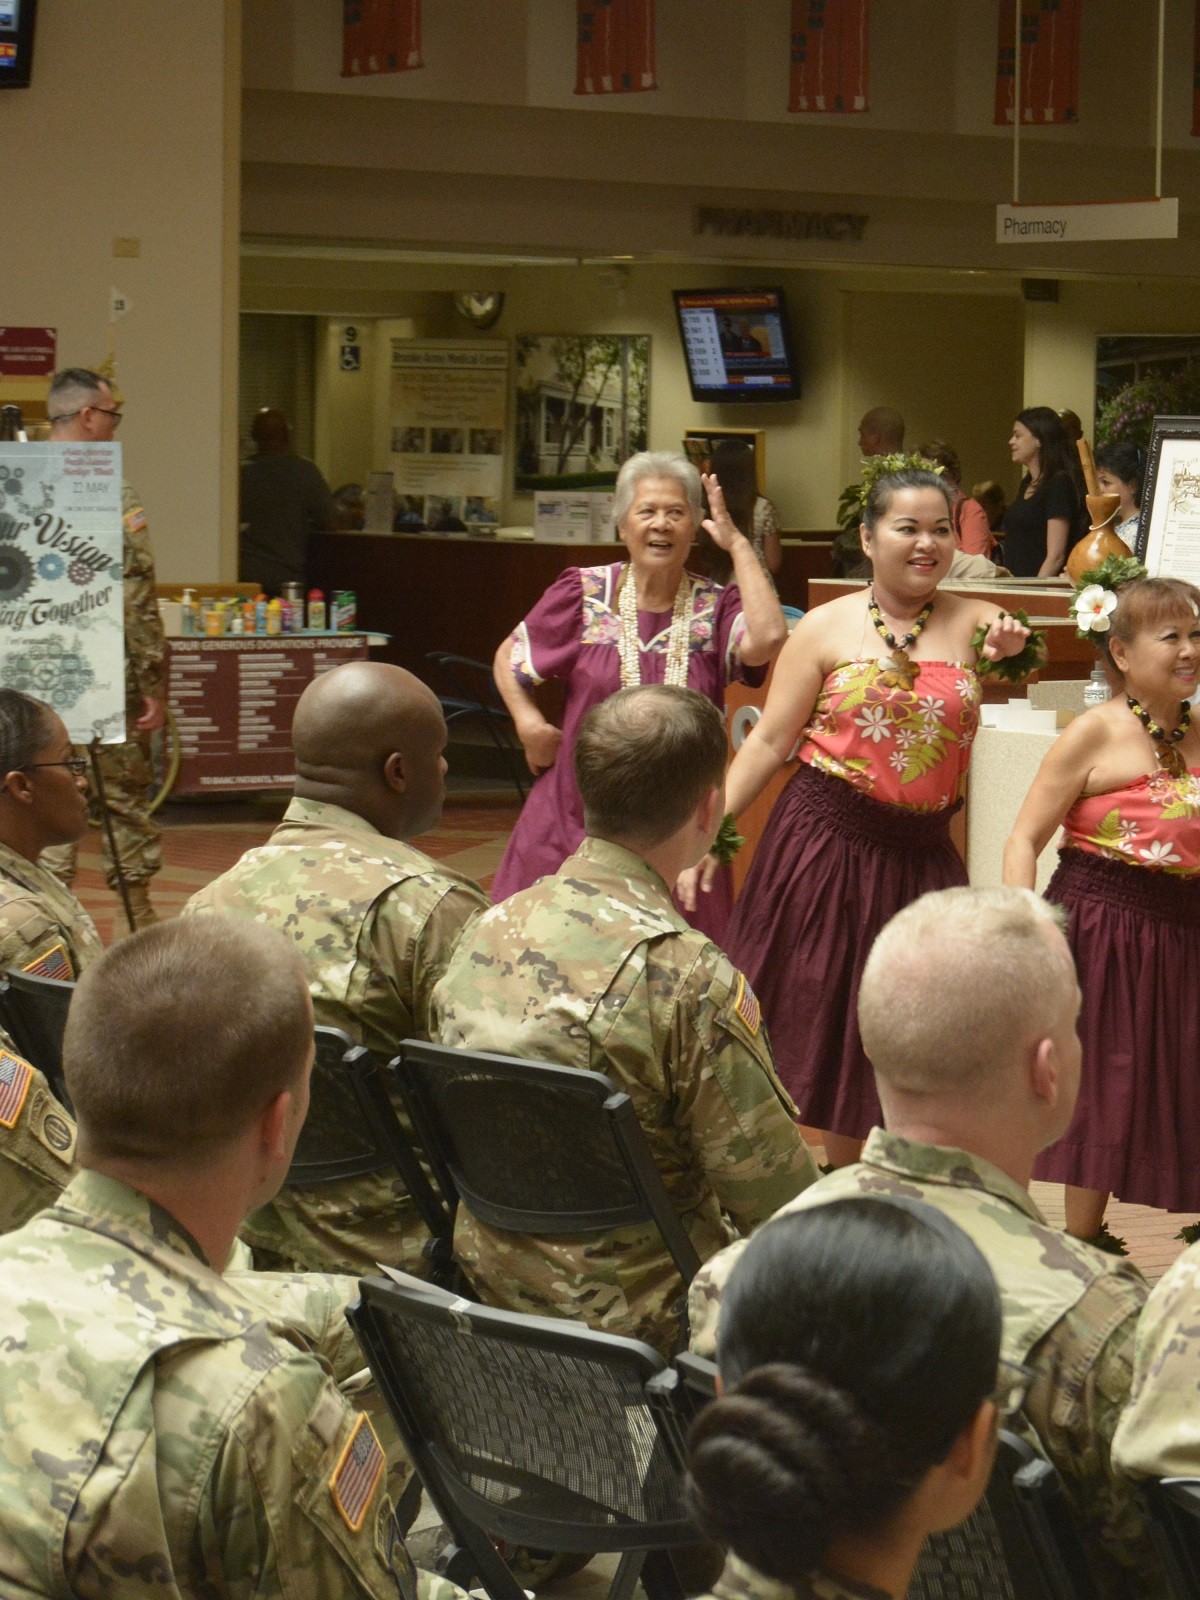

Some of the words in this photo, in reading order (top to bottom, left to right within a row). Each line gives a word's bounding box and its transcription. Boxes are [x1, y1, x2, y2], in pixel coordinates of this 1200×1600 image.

[1003, 217, 1067, 238] Pharmacy
[86, 481, 111, 493] MAY
[0, 520, 30, 541] ur
[34, 513, 114, 572] Vision
[0, 604, 28, 632] ing
[29, 586, 113, 626] Together
[201, 639, 256, 650] GENEROUS
[257, 638, 316, 650] DONATIONS
[317, 637, 363, 649] PROVIDE
